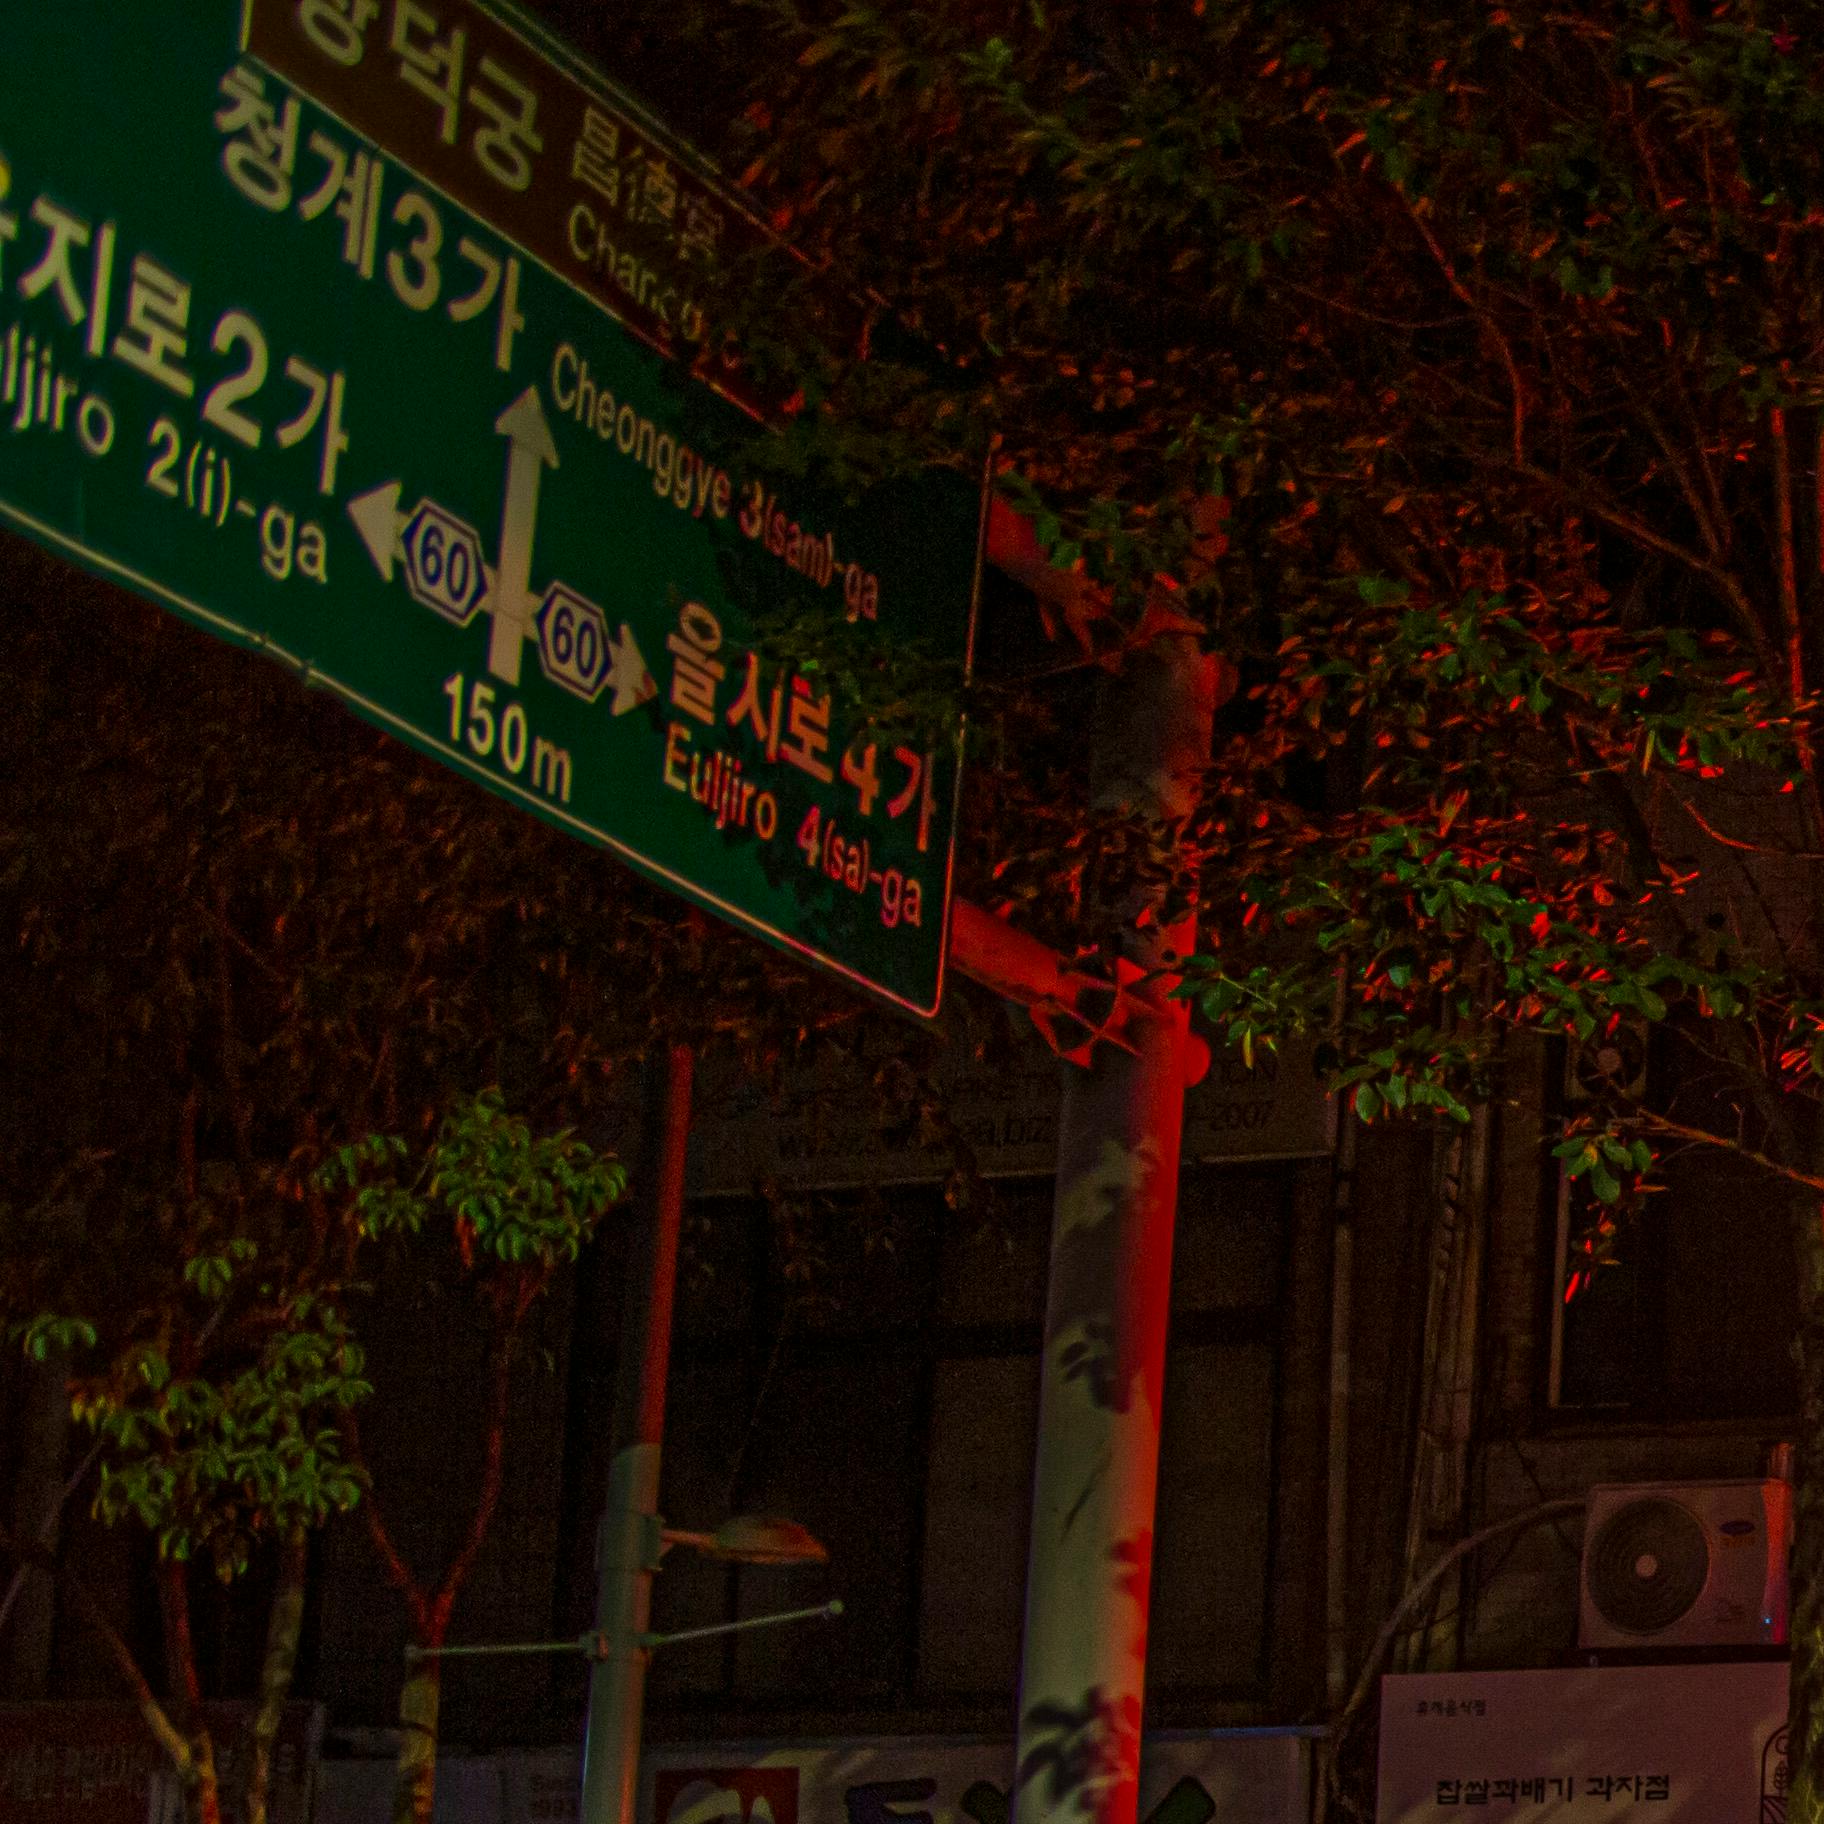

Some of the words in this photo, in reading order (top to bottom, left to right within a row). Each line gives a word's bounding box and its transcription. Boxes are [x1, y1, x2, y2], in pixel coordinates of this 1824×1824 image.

[216, 66, 526, 372] 청계3가
[0, 197, 349, 496] 지로2가
[0, 321, 116, 457] ljiro
[146, 414, 329, 585] 2(i)-ga
[420, 519, 474, 583] 60
[551, 342, 731, 518] Cheonggye
[739, 480, 880, 624] 3(sam)-ga
[551, 606, 599, 678] 60
[663, 720, 779, 841] Euljiro
[796, 804, 923, 929] 4(sa)-ga
[1584, 1774, 1670, 1802] 과자점
